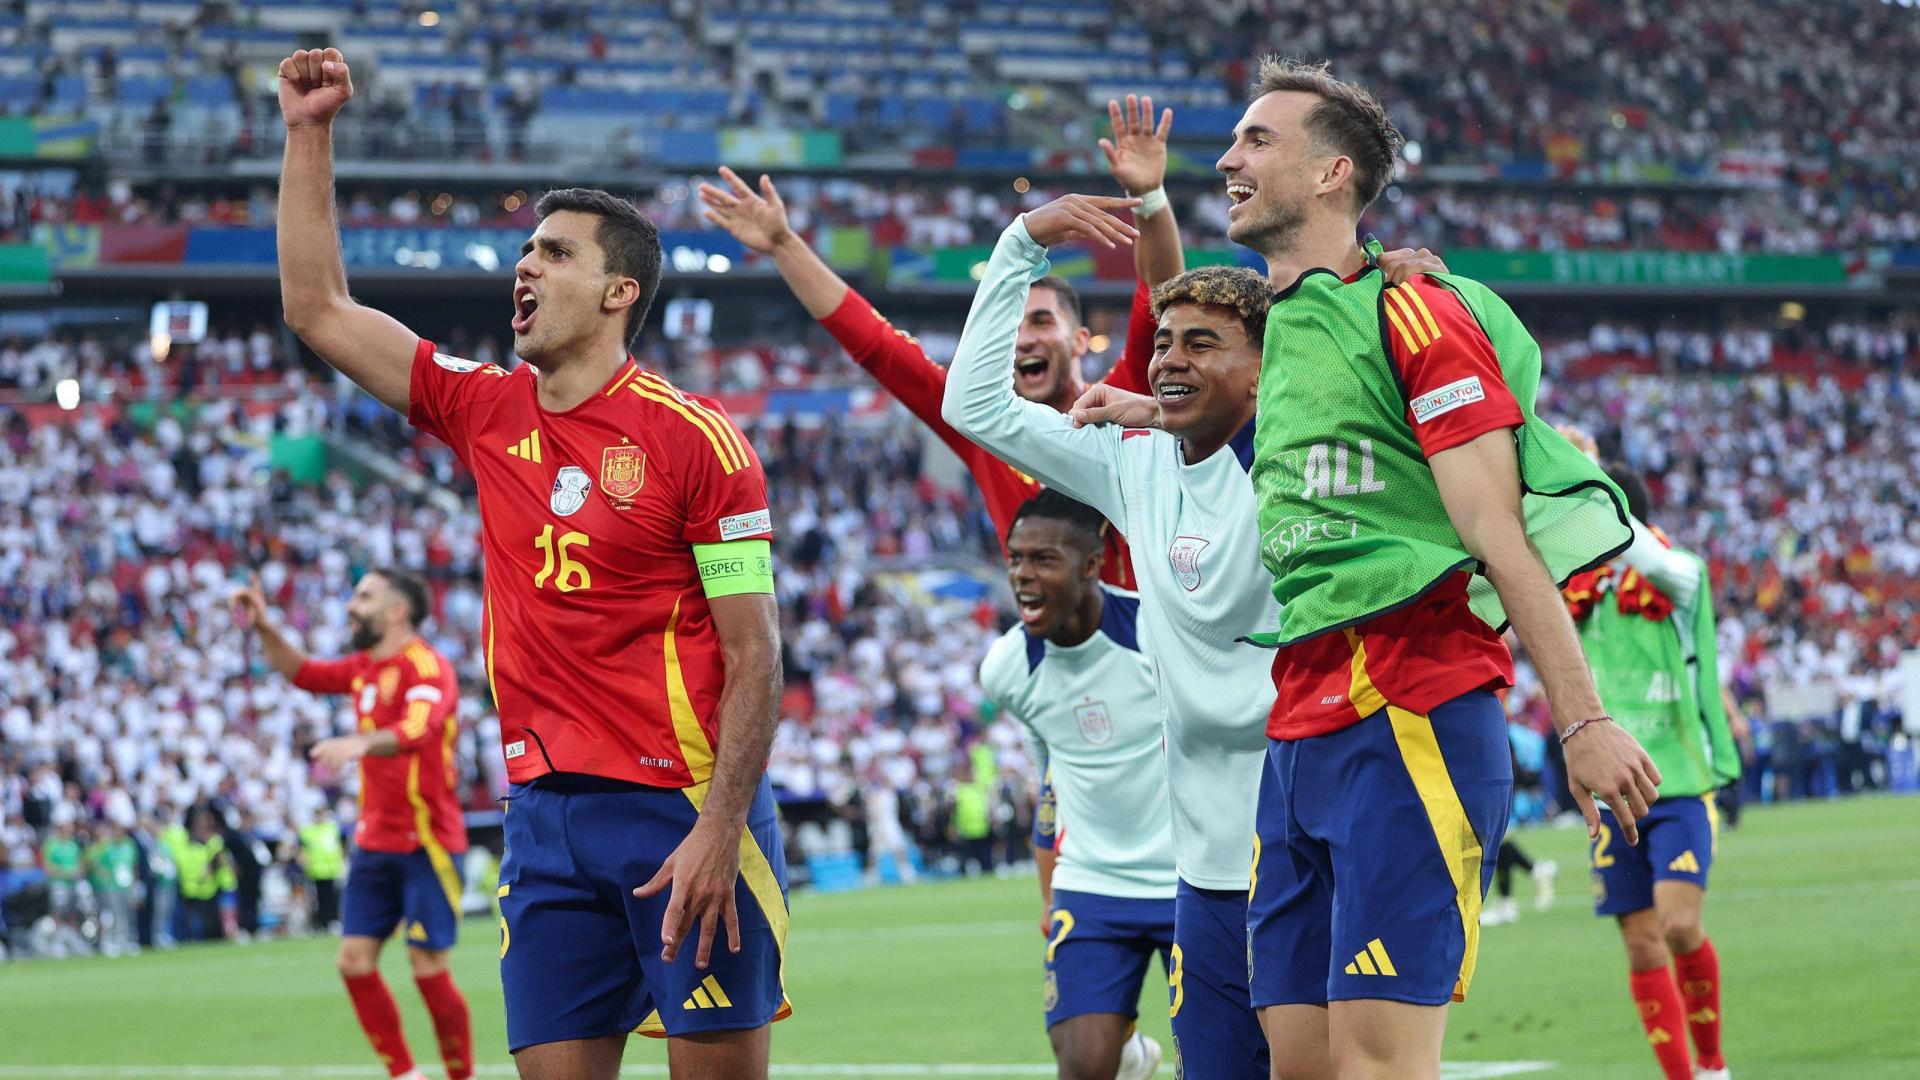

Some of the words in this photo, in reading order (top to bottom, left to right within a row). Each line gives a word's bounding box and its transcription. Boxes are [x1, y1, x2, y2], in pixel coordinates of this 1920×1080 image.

[1414, 383, 1481, 415] FOUNDATION
[1302, 439, 1386, 500] ALL
[534, 524, 591, 593] 16
[700, 561, 745, 577] RESPECT
